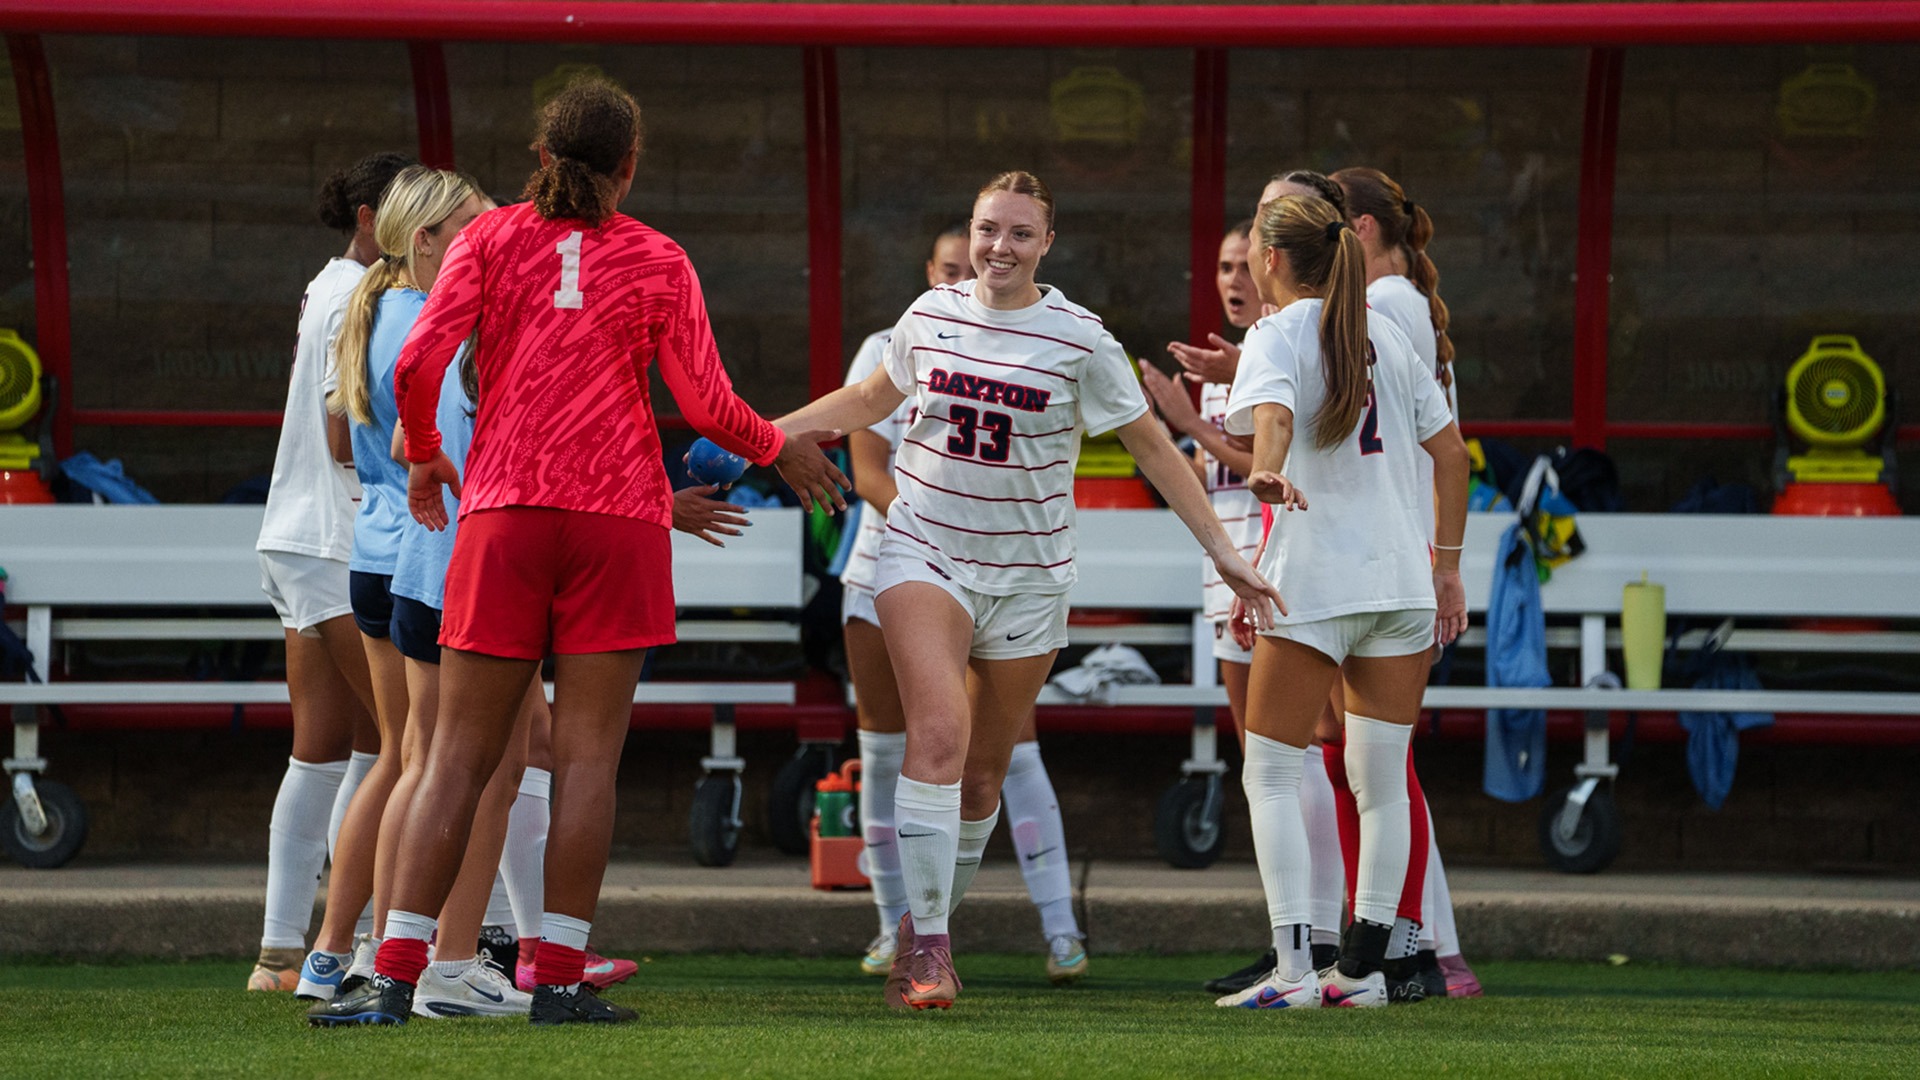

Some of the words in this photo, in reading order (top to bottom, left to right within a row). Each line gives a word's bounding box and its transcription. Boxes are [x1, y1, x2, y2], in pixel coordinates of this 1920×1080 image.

[554, 231, 584, 310] 1
[928, 367, 1052, 413] DAYTON
[947, 403, 1013, 463] 33
